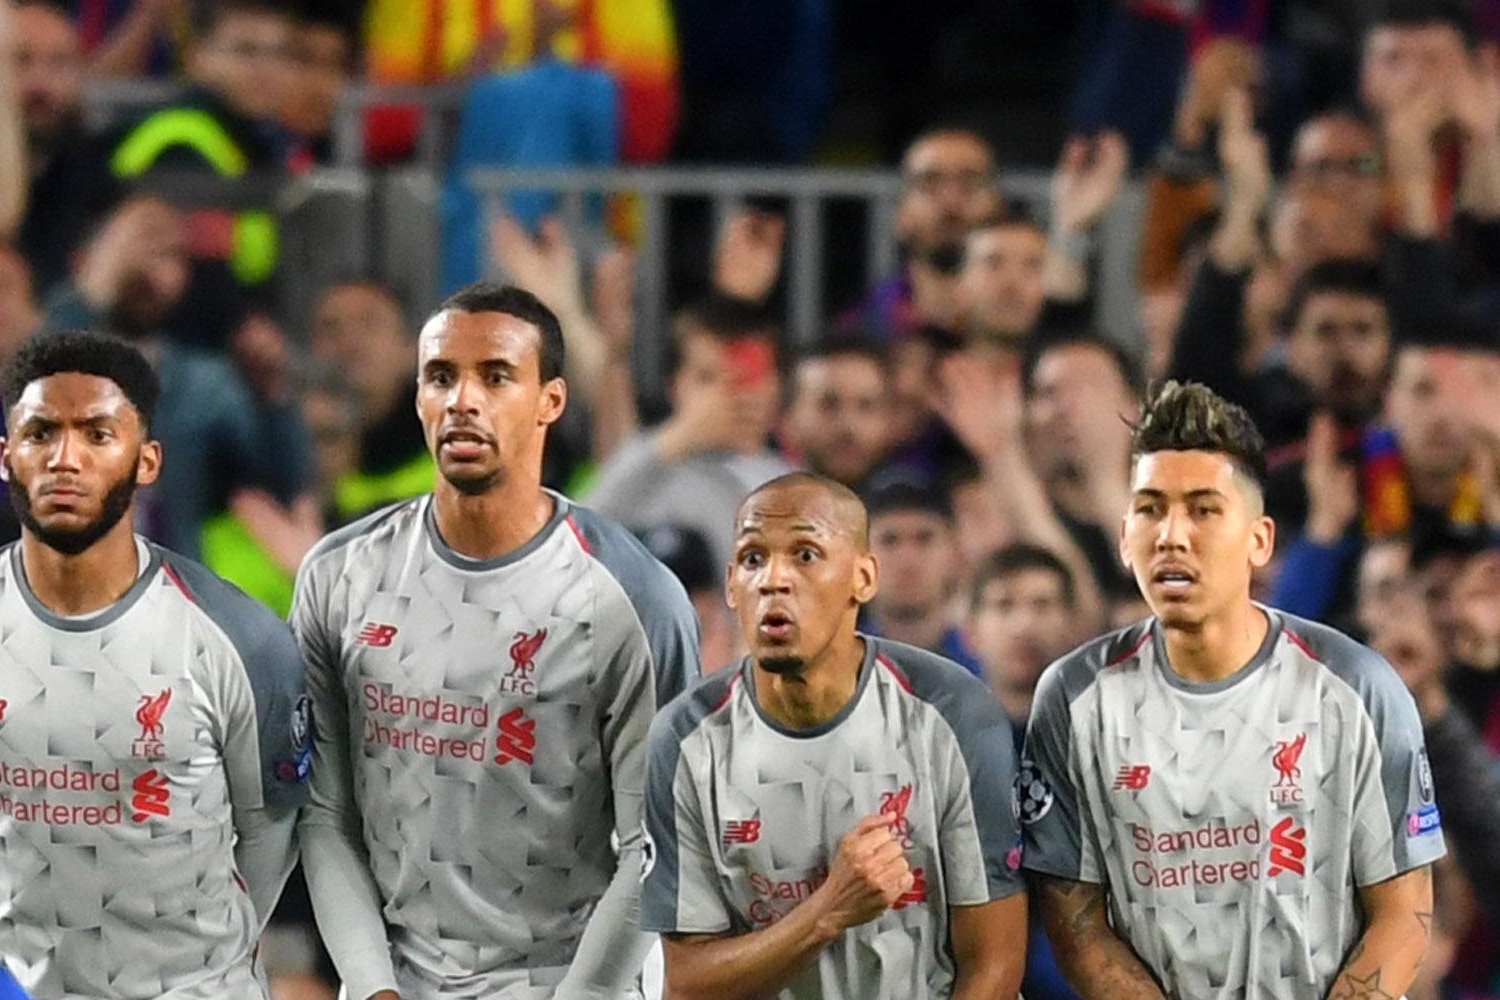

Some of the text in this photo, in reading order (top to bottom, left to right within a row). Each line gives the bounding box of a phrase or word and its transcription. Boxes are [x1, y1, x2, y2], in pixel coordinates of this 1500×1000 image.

[363, 683, 489, 728] Standard
[132, 742, 165, 757] LFC
[1270, 788, 1303, 802] LFC
